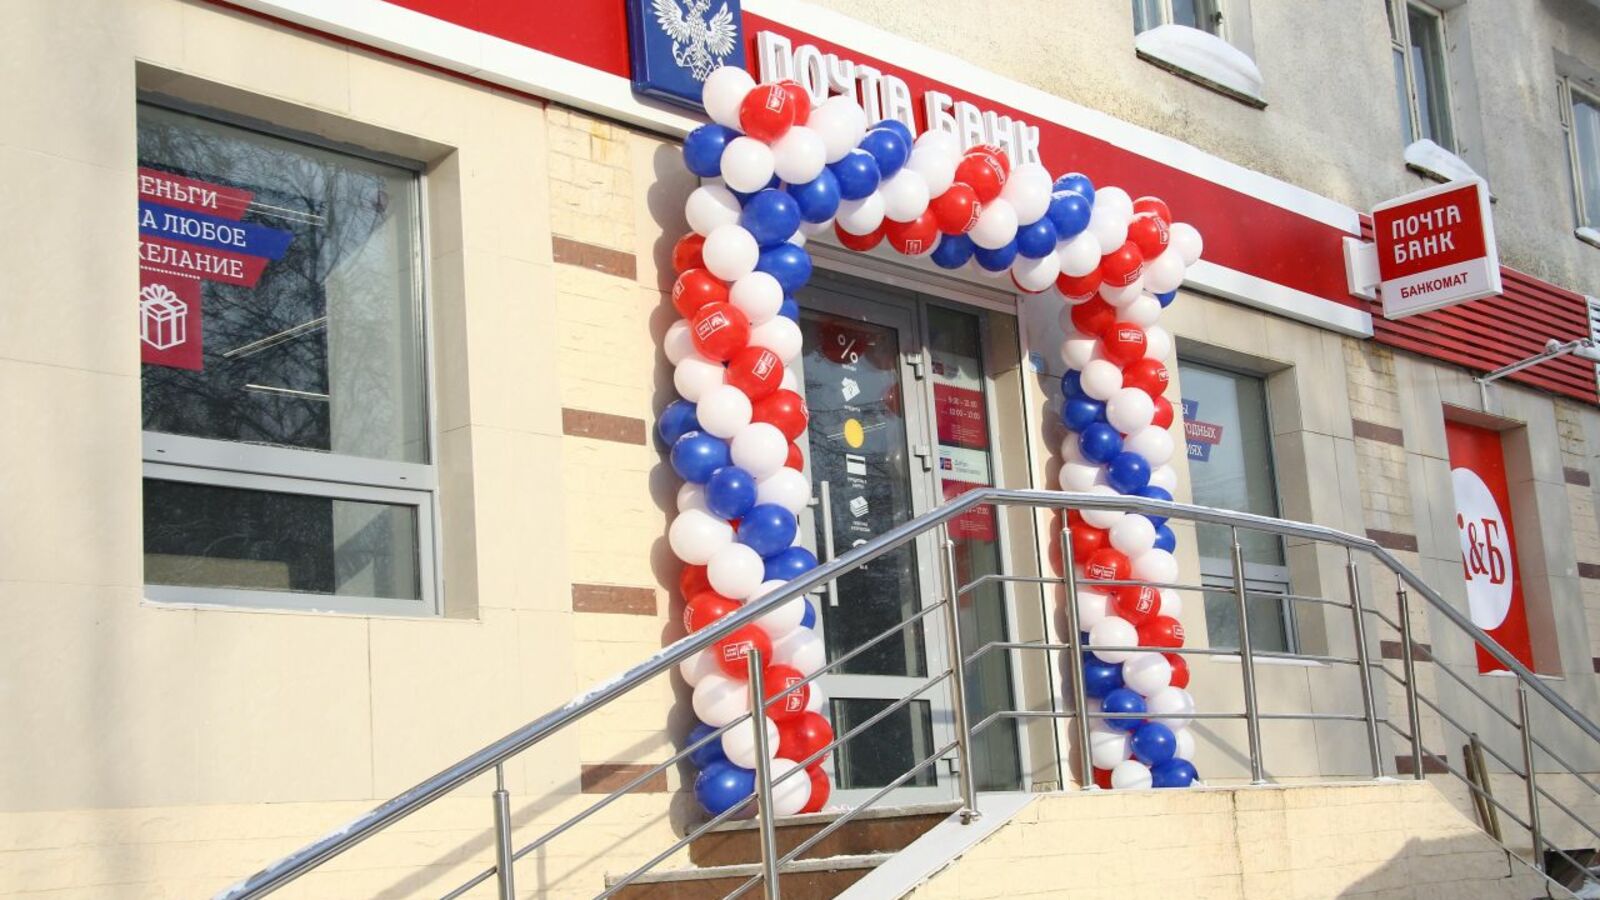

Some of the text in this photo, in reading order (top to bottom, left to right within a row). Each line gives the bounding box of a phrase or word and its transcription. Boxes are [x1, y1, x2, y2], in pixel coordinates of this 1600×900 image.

[757, 30, 1040, 168] ПОЧТА БАНК
[139, 174, 219, 209] ЕНЬГИ
[162, 213, 247, 248] ЛЮБОЕ
[1391, 204, 1462, 240] ПОЧТА
[1393, 230, 1455, 265] БАНК
[1400, 272, 1469, 298] БАНКОМАТ
